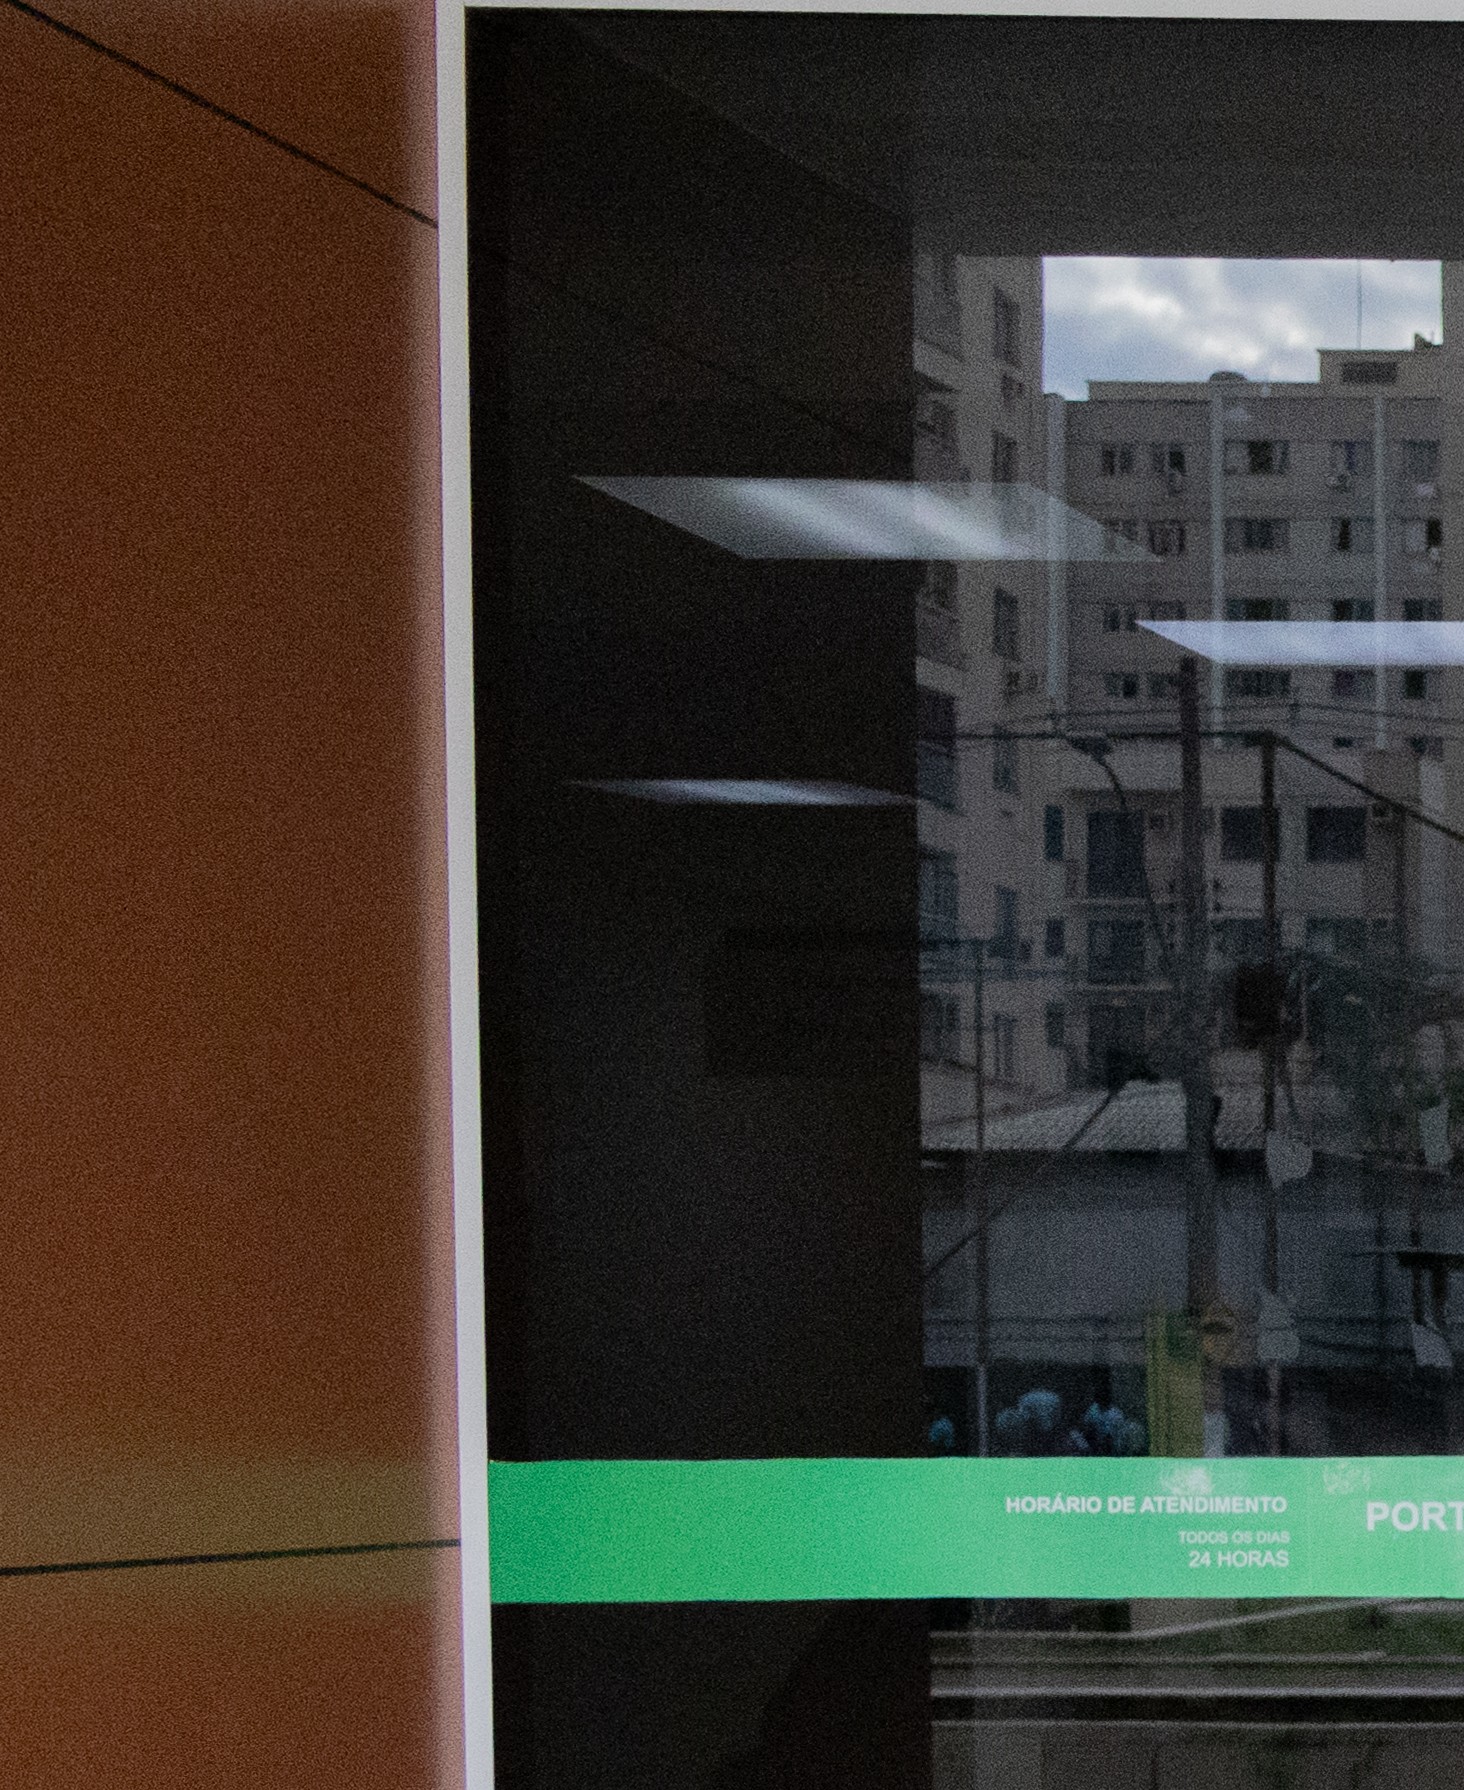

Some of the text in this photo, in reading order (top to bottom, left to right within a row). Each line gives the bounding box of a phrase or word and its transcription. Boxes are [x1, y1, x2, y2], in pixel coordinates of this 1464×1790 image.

[1005, 1492, 1288, 1514] HORÁRIO DE ATENDIMENTO
[1178, 1530, 1291, 1544] TODOS OS DIAS
[1188, 1550, 1290, 1568] 24 HORAS
